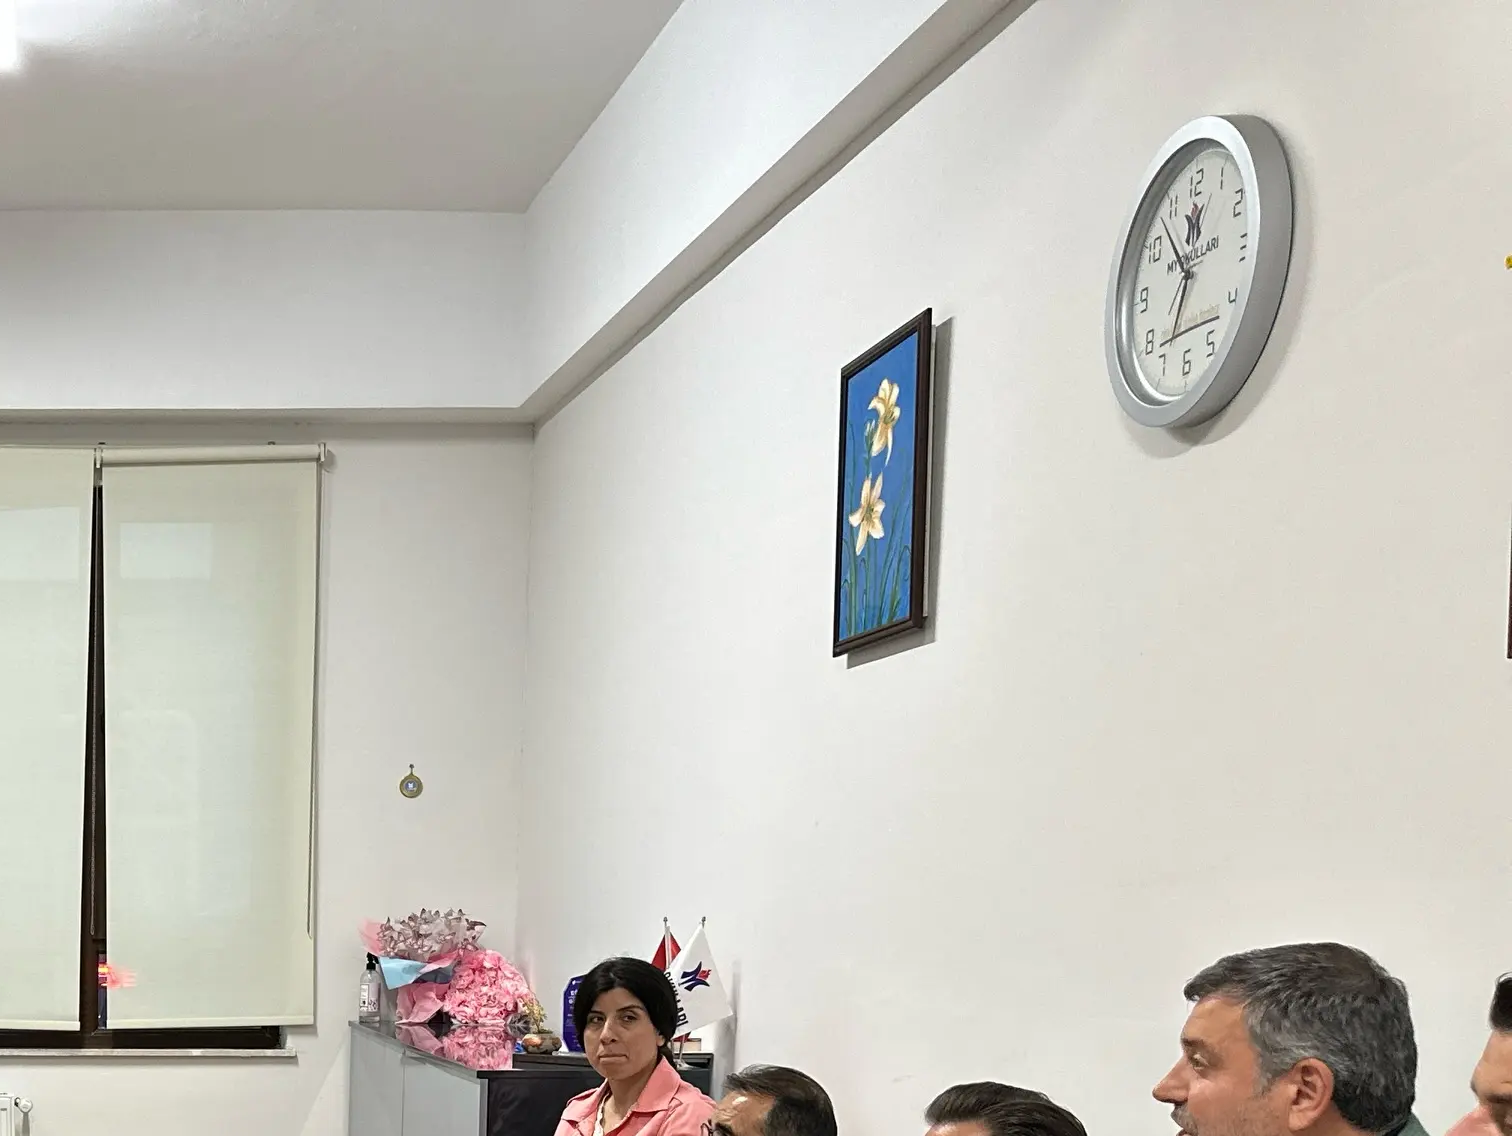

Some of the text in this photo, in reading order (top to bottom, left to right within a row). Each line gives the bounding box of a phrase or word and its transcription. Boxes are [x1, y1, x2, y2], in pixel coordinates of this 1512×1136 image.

[1189, 168, 1204, 198] 12
[1169, 194, 1179, 220] 11
[1233, 188, 1244, 218] 2
[1148, 236, 1162, 264] 10
[1140, 287, 1149, 314] 9
[1145, 329, 1154, 356] 8
[1206, 329, 1216, 358] 5
[1158, 353, 1166, 377] 7
[1182, 348, 1192, 376] 6
